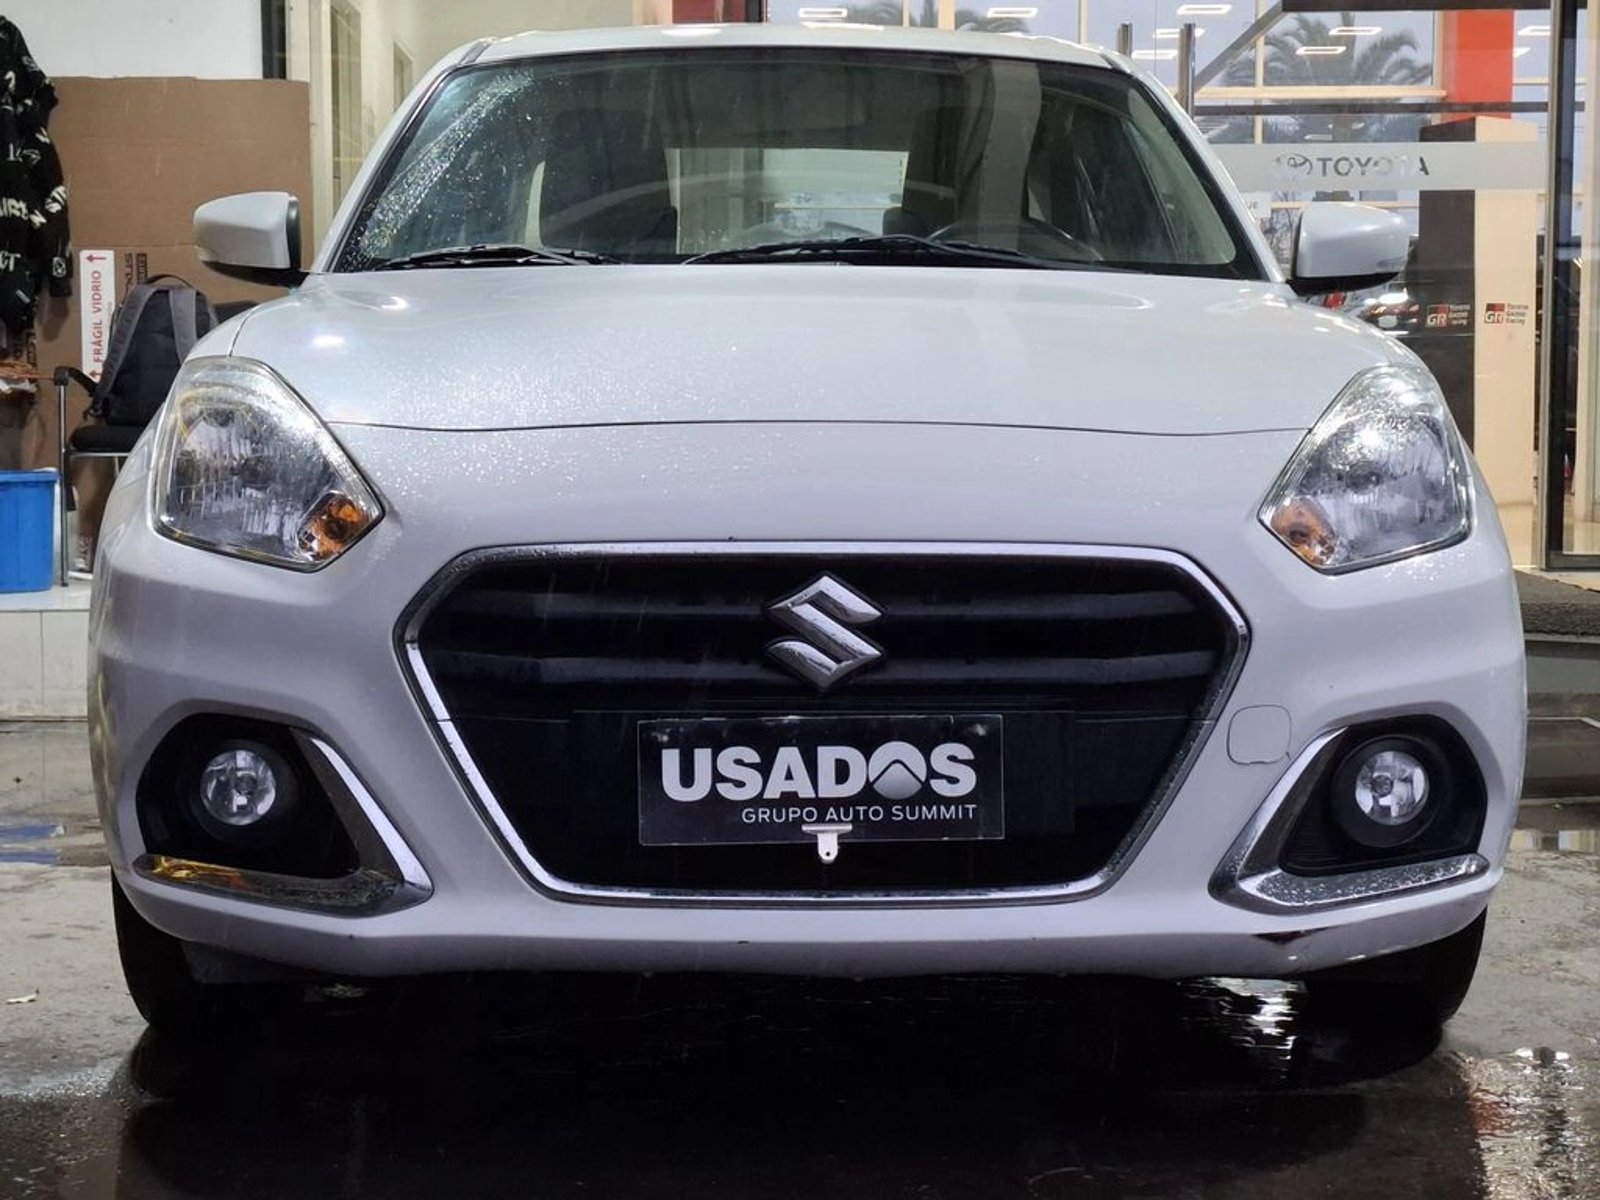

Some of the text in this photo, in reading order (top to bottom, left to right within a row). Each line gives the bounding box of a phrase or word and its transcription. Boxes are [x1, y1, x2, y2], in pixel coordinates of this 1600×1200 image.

[90, 270, 102, 314] VIDRIO
[661, 741, 977, 801] USADOS
[741, 804, 977, 823] GRUPO AUTO SUMMIT
